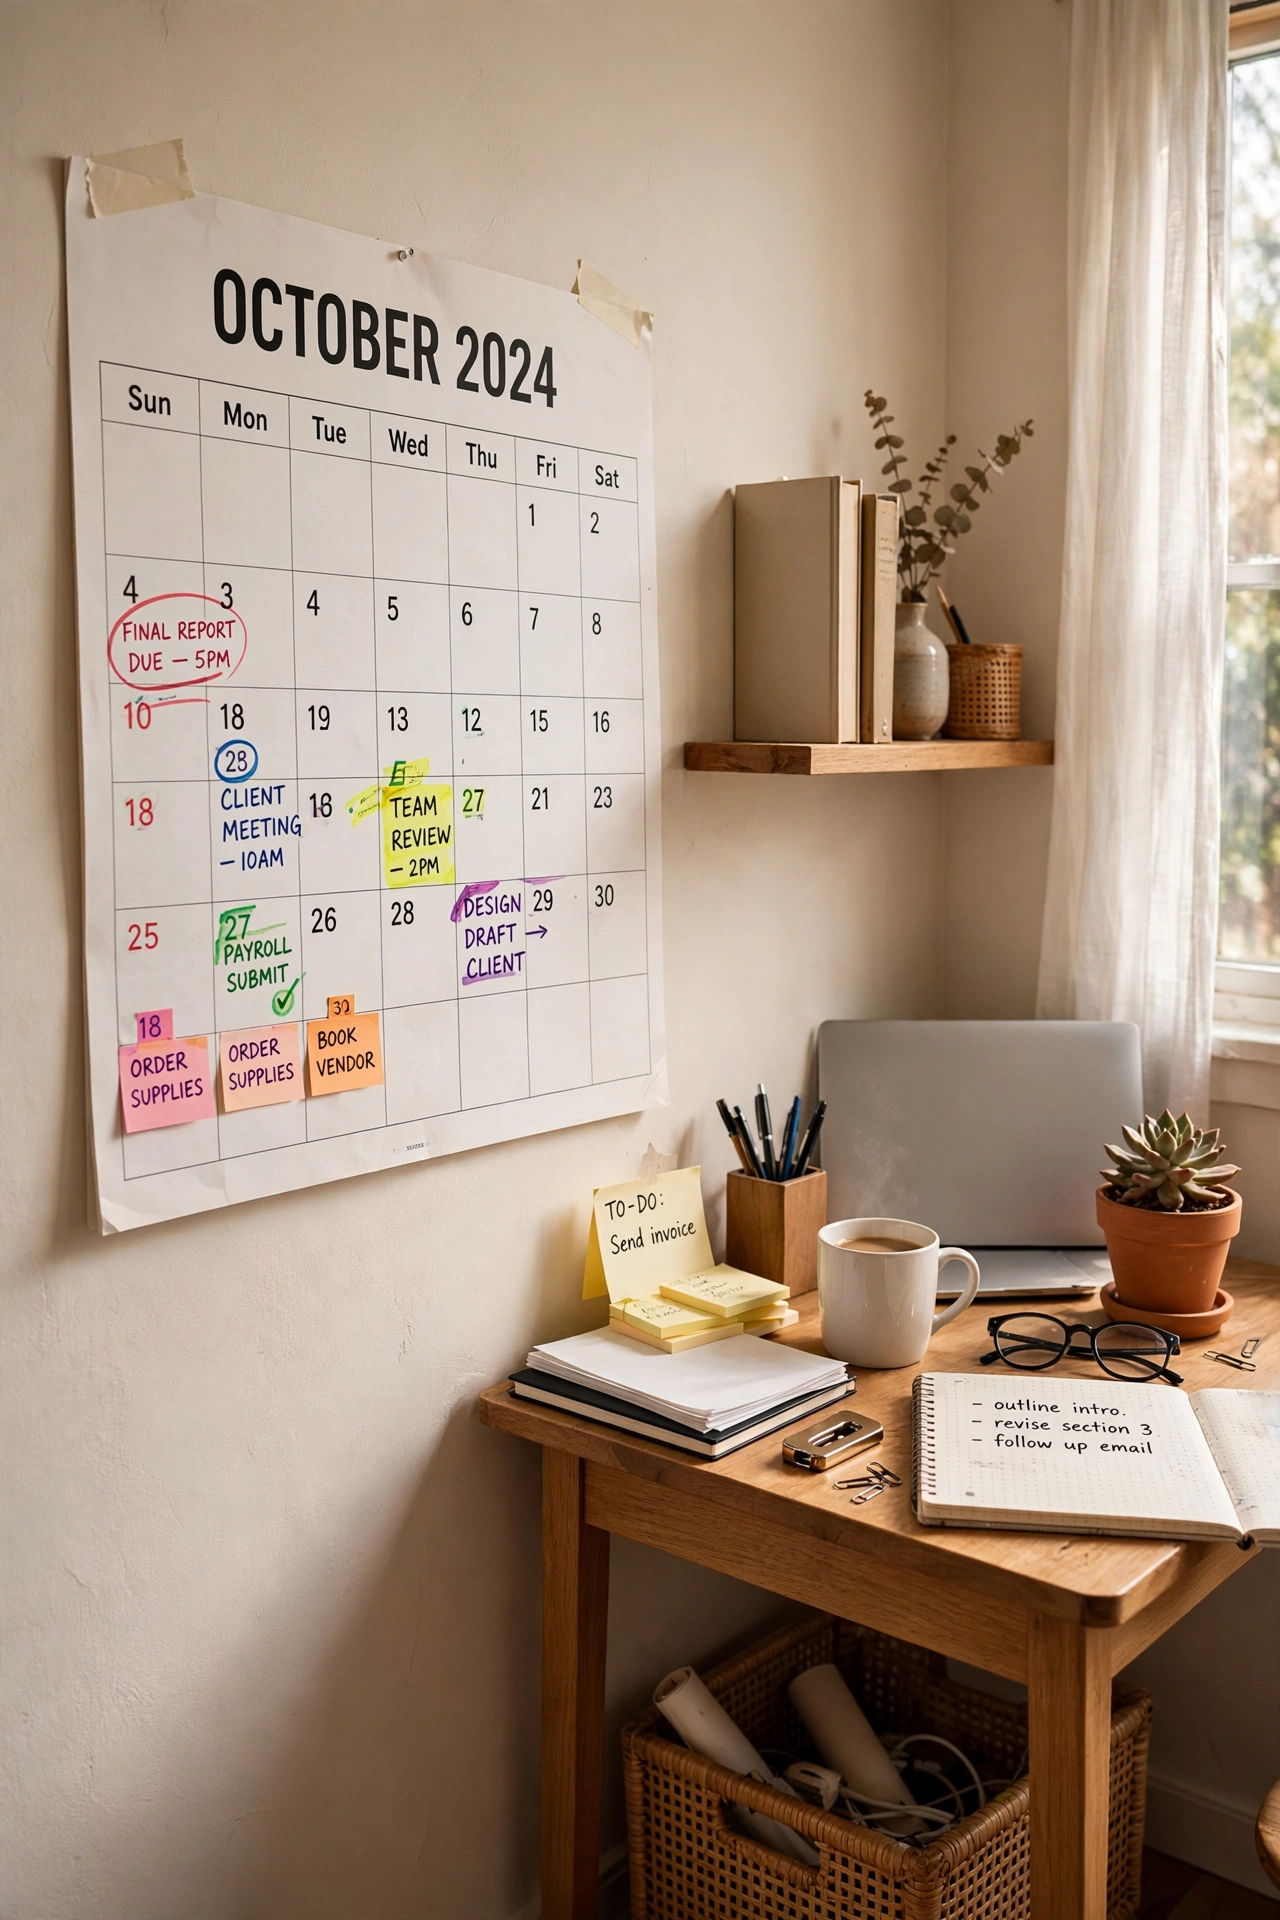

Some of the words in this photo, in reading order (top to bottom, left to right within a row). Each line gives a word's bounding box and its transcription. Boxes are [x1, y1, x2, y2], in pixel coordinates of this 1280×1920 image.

[213, 268, 441, 385] OCTOBER
[456, 325, 557, 408] 2024
[128, 385, 171, 416] Sun
[223, 401, 267, 431] Mon
[312, 416, 347, 444] Tue
[388, 429, 429, 458] Wed
[465, 443, 497, 469] Thu
[536, 454, 557, 479] Fri
[594, 465, 619, 489] Sat
[528, 504, 535, 527] 1
[590, 512, 600, 534] 2
[123, 575, 139, 604] 4
[220, 582, 233, 609] 3
[307, 590, 320, 616] 4
[387, 596, 399, 621] 5
[461, 602, 473, 627] 6
[122, 622, 171, 642] FINAL
[178, 620, 236, 640] REPORT
[529, 607, 539, 630] 7
[592, 613, 602, 635] 8
[128, 652, 163, 673] DUE
[196, 649, 231, 669] 5PM
[124, 702, 151, 729] 10
[220, 703, 244, 730] 18
[308, 705, 330, 730] 19
[387, 706, 409, 732] 13
[462, 708, 482, 732] 12
[530, 710, 549, 733] 15
[592, 711, 610, 733] 16
[226, 750, 248, 772] 28
[221, 785, 285, 811] CLIENT
[389, 795, 437, 818] TEAM
[463, 789, 484, 813] 27
[531, 787, 549, 810] 21
[593, 787, 613, 809] 23
[125, 797, 154, 826] 18
[223, 815, 301, 842] MEETING
[392, 825, 451, 851] REVIEW
[241, 847, 284, 871] 10AM
[409, 856, 439, 877] 2PM
[464, 893, 522, 918] DESIGN
[533, 889, 553, 912] 29
[594, 884, 614, 907] 30
[311, 907, 336, 933] 26
[391, 901, 415, 926] 28
[128, 922, 159, 951] 25
[224, 914, 251, 941] 27
[465, 923, 517, 949] DRAFT
[224, 936, 292, 965] PAYROLL
[467, 951, 526, 979] CLIENT
[226, 963, 289, 993] SUBMIT
[139, 1015, 162, 1039] 18
[317, 1027, 357, 1050] BOOK
[228, 1037, 280, 1063] ORDER
[130, 1051, 188, 1078] ORDER
[316, 1050, 375, 1077] VENDOR
[228, 1062, 294, 1091] SUPPLIES
[131, 1078, 203, 1109] SUPPLIES
[604, 1192, 664, 1221] TO-DO:
[610, 1226, 644, 1255] Send
[650, 1220, 697, 1245] invoice
[994, 1399, 1061, 1413] outline
[1072, 1401, 1127, 1417] intro.
[994, 1419, 1051, 1431] revise
[1062, 1421, 1130, 1435] section
[1140, 1423, 1152, 1436] 3
[994, 1434, 1052, 1449] follow
[1064, 1441, 1088, 1454] up
[1099, 1441, 1153, 1455] email
